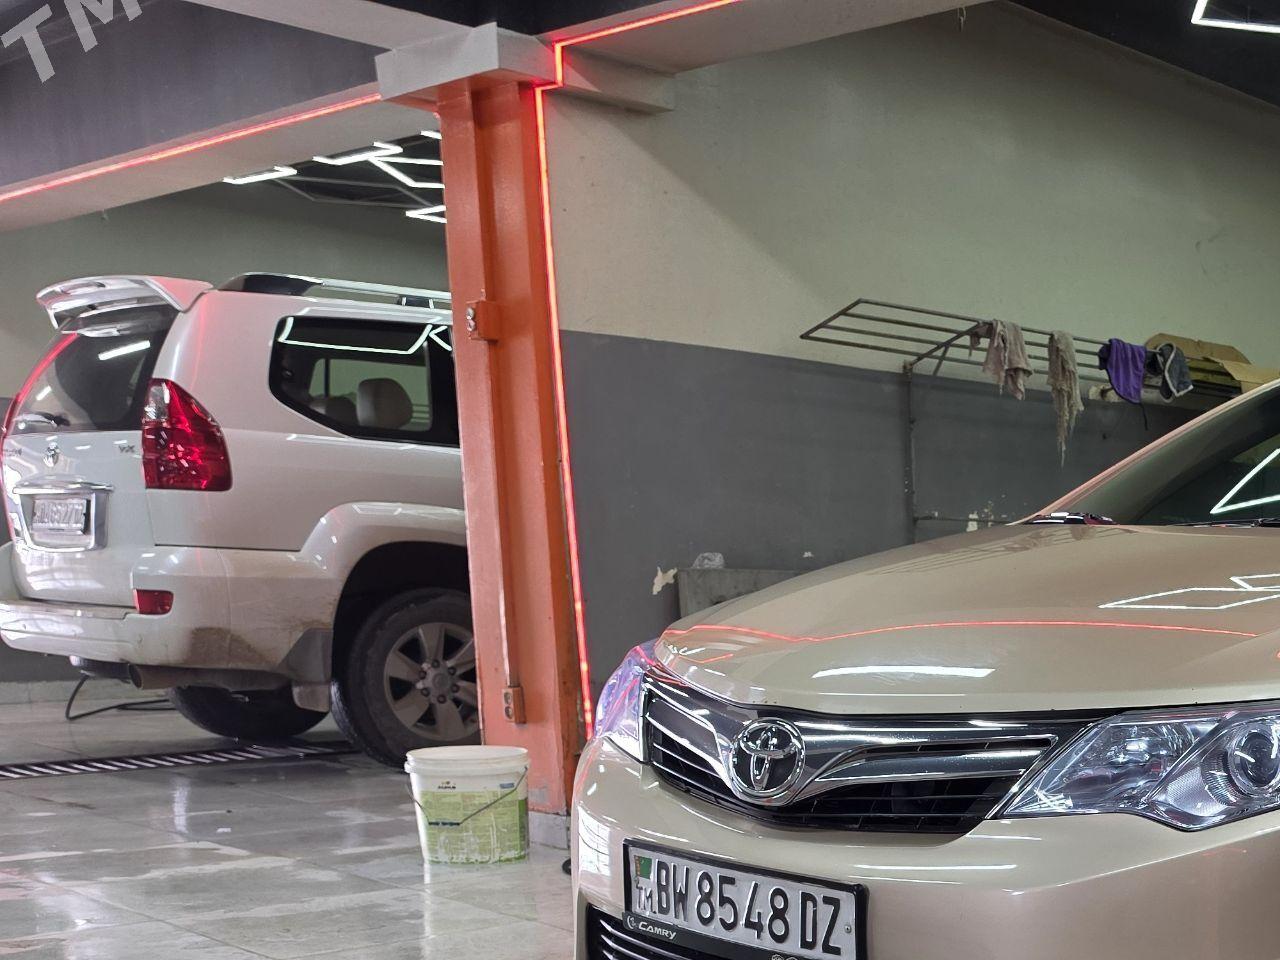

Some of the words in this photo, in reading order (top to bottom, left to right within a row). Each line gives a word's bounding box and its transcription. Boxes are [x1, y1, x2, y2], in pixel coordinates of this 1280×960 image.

[656, 859, 689, 922] BW
[696, 871, 789, 943] 8548
[801, 890, 841, 955] DZ
